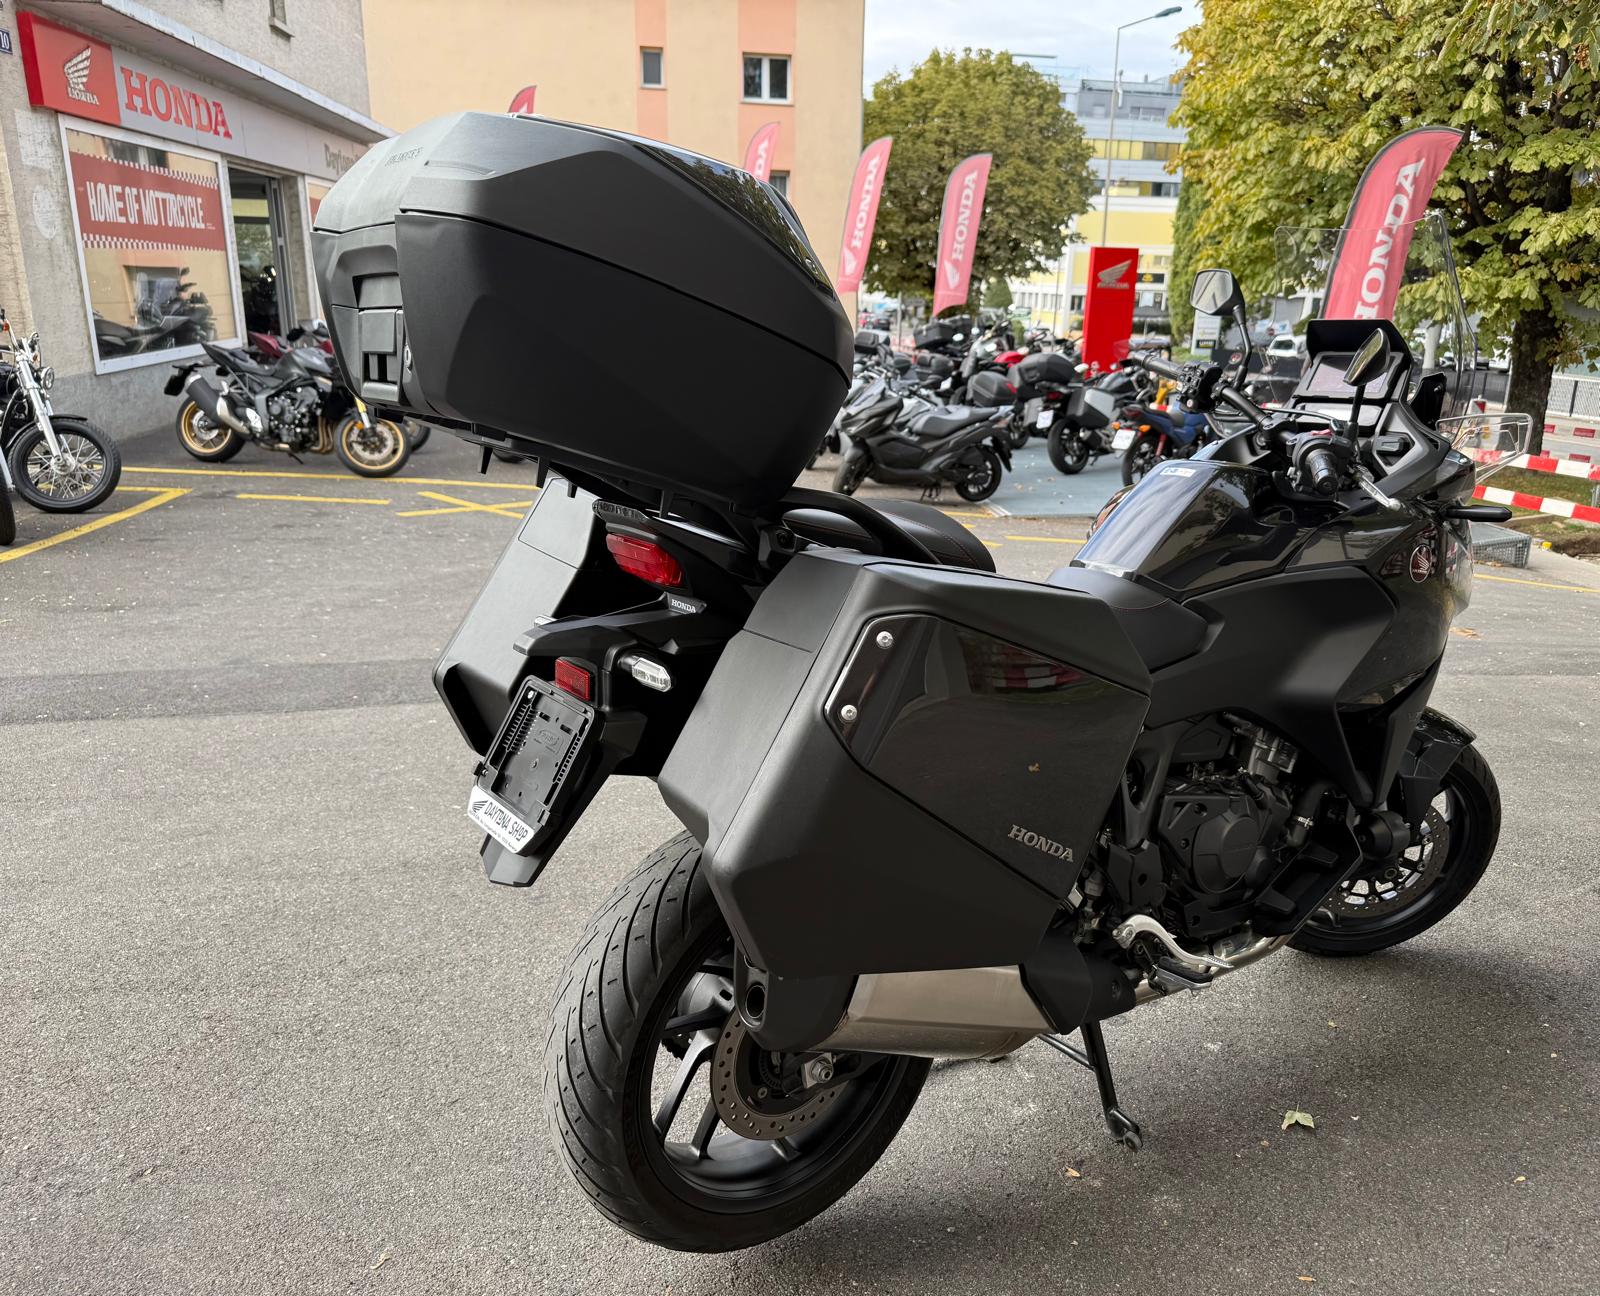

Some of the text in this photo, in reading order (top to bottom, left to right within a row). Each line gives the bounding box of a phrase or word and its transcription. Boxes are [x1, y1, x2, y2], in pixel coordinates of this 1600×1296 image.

[120, 65, 232, 140] HONDA
[86, 181, 205, 229] HOME OF MOTORCYCLE
[852, 153, 880, 249] HONDA
[952, 170, 978, 262] HONDA
[1353, 157, 1426, 320] HONDA
[671, 598, 697, 614] HONDA
[484, 801, 510, 832] DAYTONA
[508, 821, 528, 842] SHOP
[1007, 824, 1074, 863] HONDA
